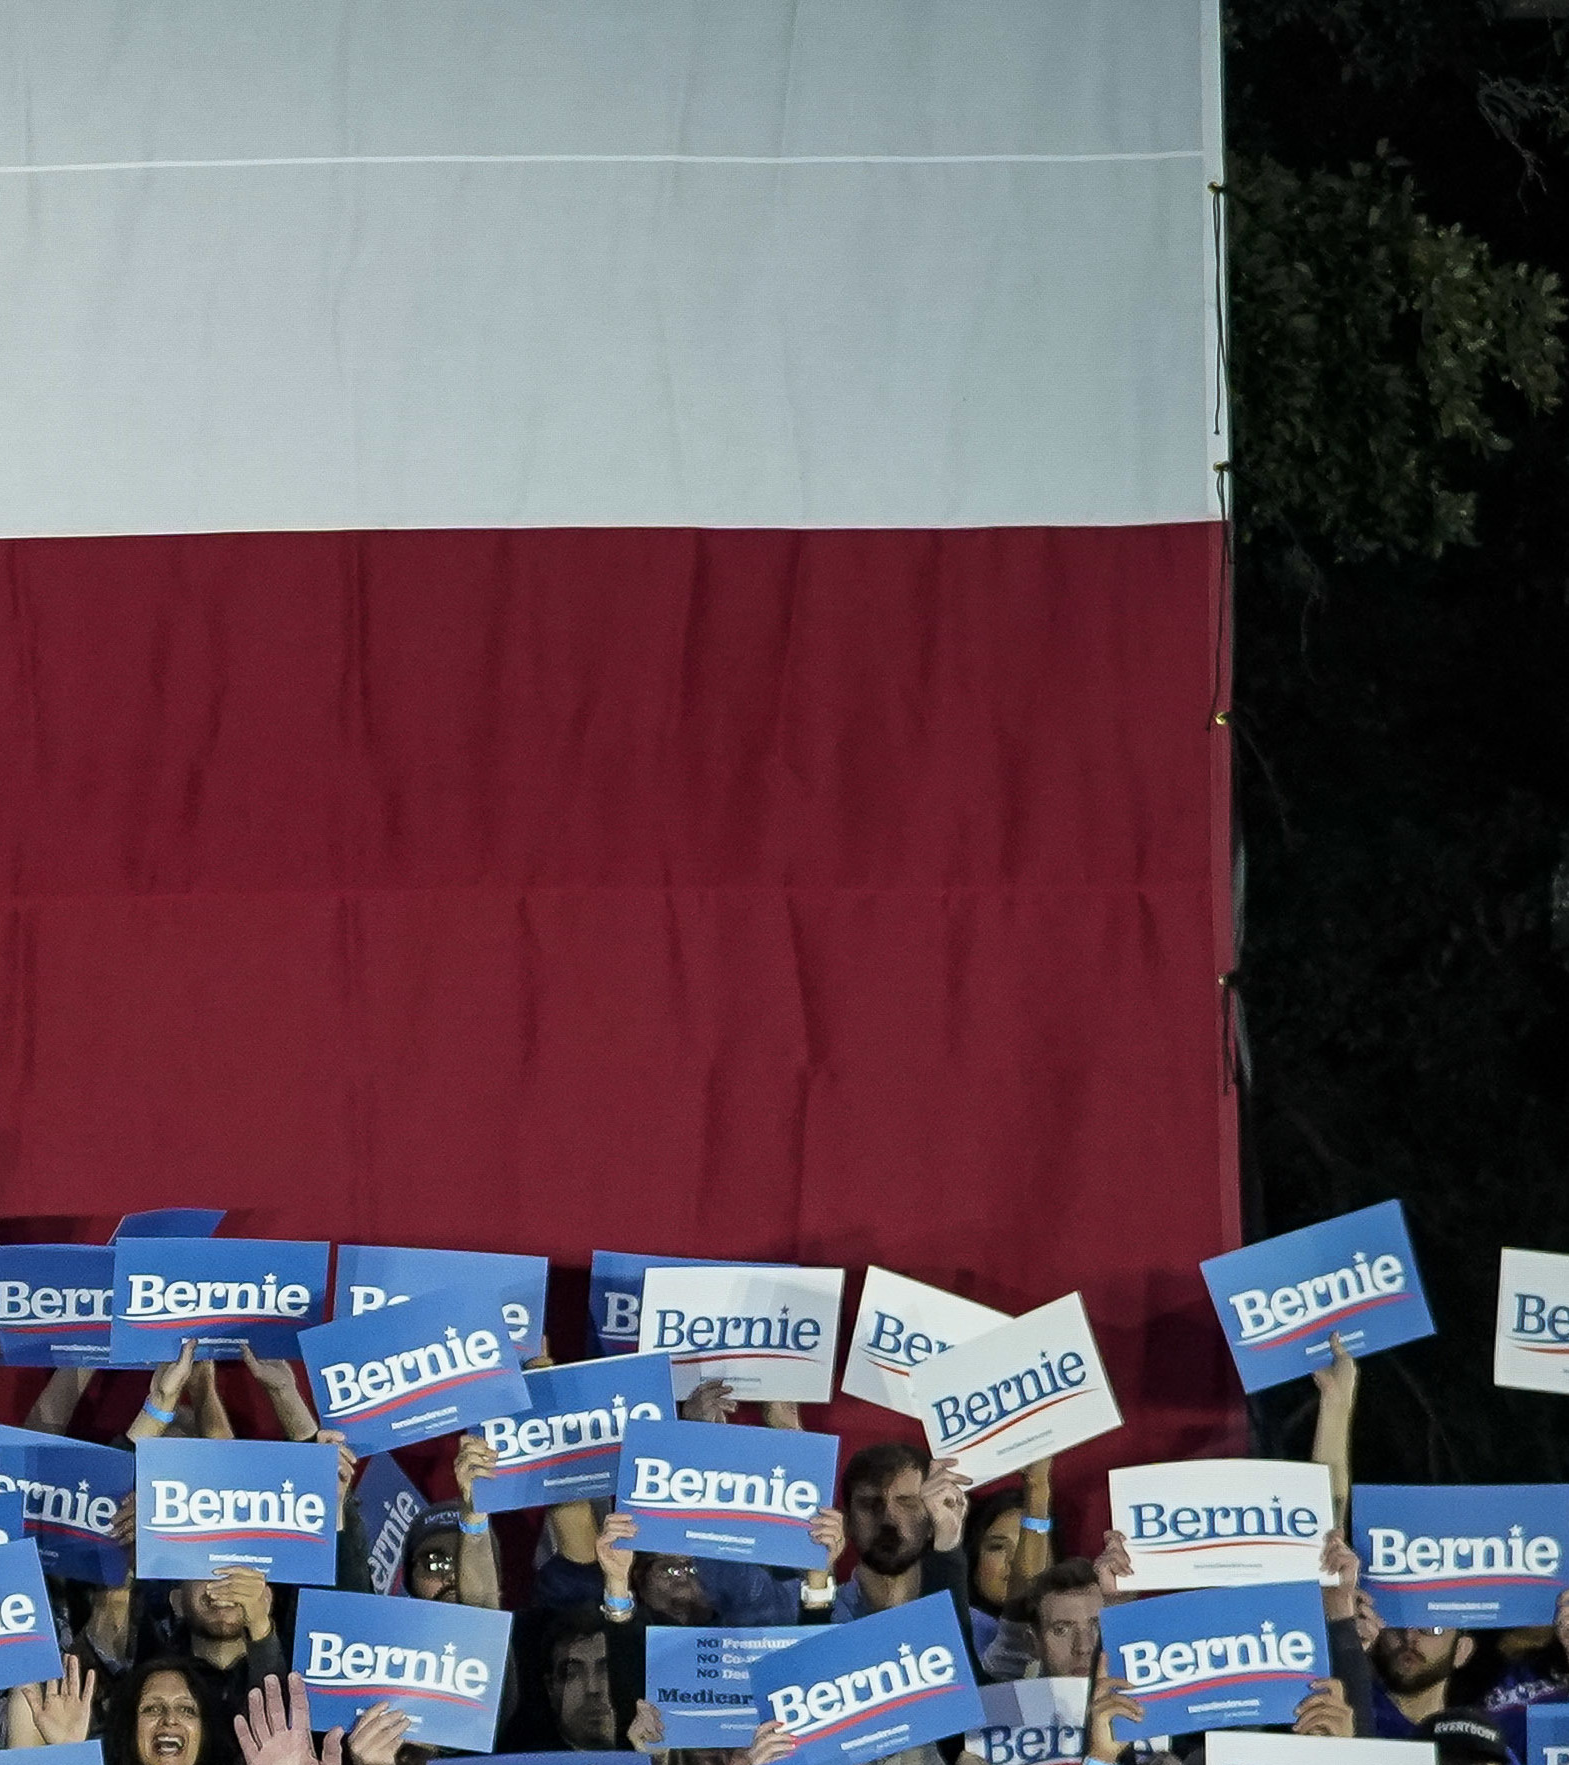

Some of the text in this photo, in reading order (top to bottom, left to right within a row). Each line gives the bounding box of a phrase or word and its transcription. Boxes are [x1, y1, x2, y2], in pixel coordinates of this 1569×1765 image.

[126, 1273, 311, 1318] Bernie
[1229, 1251, 1407, 1341] Bernie
[654, 1304, 821, 1352] Bernie
[320, 1325, 502, 1412] Bernie
[933, 1350, 1087, 1442] Bernie
[149, 1480, 326, 1527] Bernie
[630, 1457, 819, 1517] Bernie
[367, 1487, 419, 1593] ernie
[1129, 1496, 1318, 1541] Bernie
[1367, 1525, 1559, 1577] Bernie
[305, 1632, 489, 1700] Bernie
[696, 1638, 719, 1649] NO
[696, 1654, 719, 1664] NO
[1120, 1620, 1315, 1687] Bernie
[657, 1688, 755, 1705] Medicar
[696, 1669, 719, 1679] NO
[768, 1642, 955, 1732] Bernie
